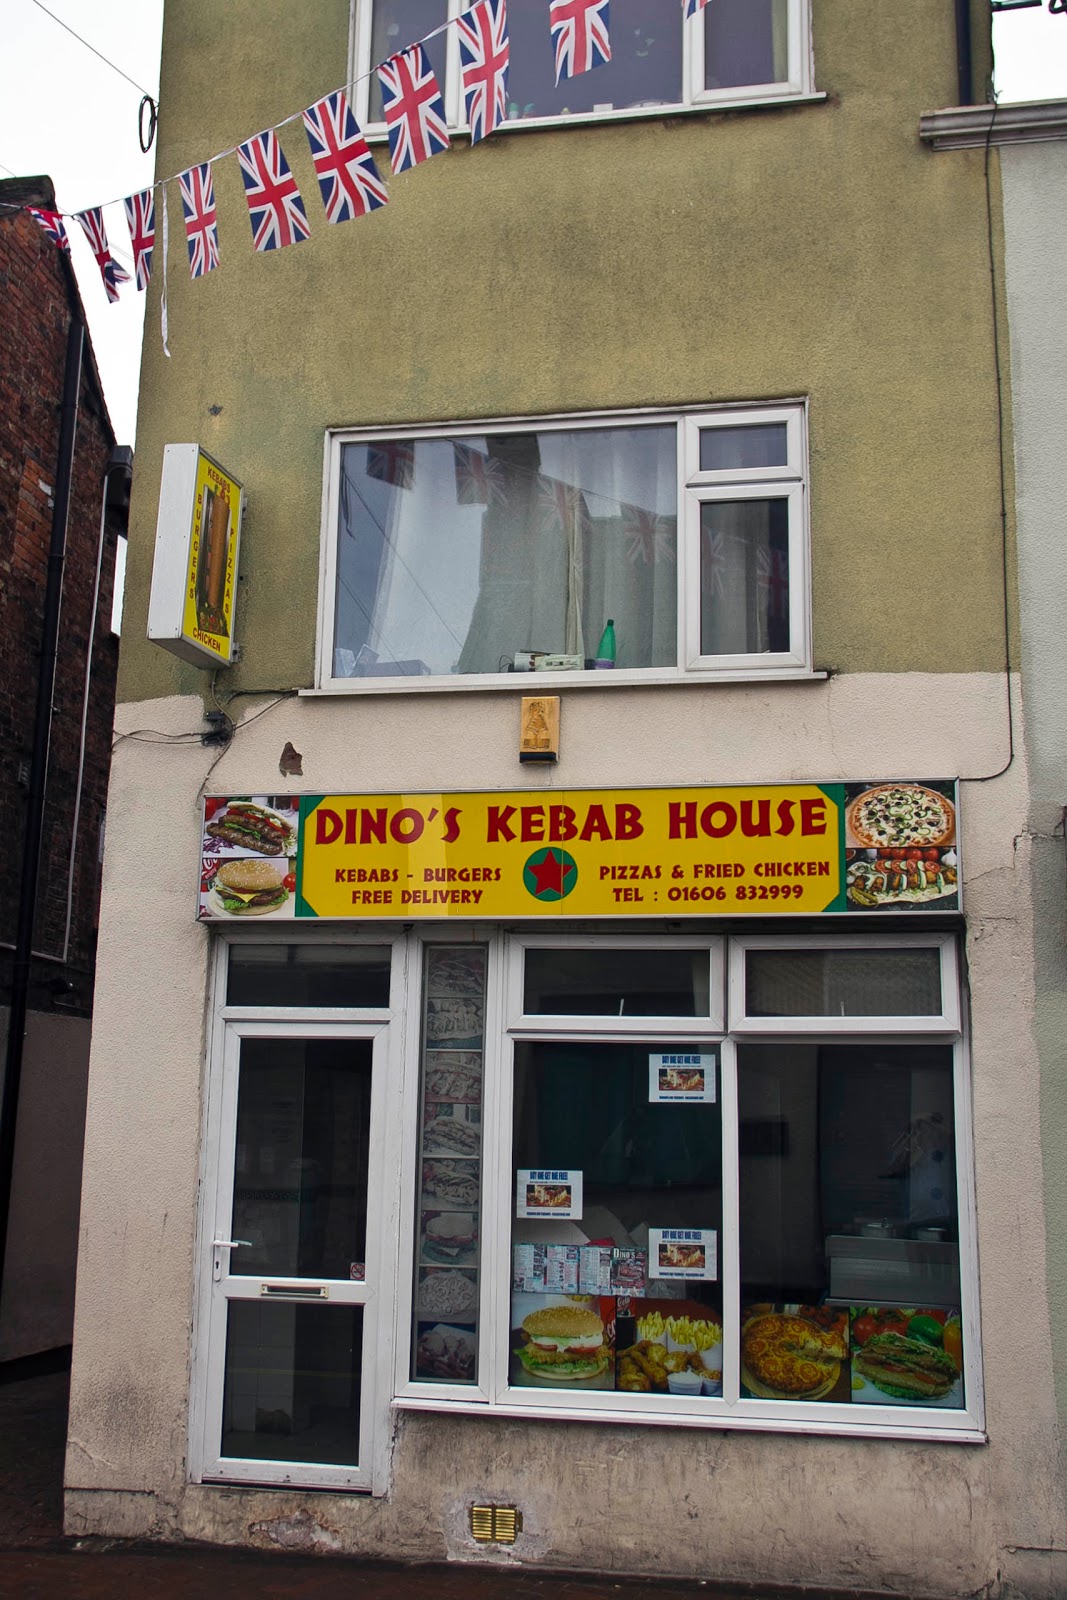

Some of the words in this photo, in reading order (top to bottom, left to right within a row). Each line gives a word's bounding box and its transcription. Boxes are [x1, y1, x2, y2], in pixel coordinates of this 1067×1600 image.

[207, 466, 231, 494] KEBABS
[189, 494, 203, 599] BURGERS
[225, 528, 235, 614] PIZZAS
[192, 627, 222, 653] CHICKEN
[315, 807, 463, 845] DINO'S
[486, 802, 645, 843] KEBAB
[668, 798, 828, 840] HOUSE
[334, 868, 400, 883] KEBABS
[424, 867, 502, 883] BURGERS
[599, 864, 662, 881] PIZZAS
[671, 864, 685, 880] &
[693, 863, 746, 879] FRIED
[753, 861, 831, 878] CHICKEN
[351, 889, 393, 904] FREE
[400, 889, 483, 904] DELIVERY
[667, 885, 727, 902] 01606
[735, 884, 804, 901] 832999
